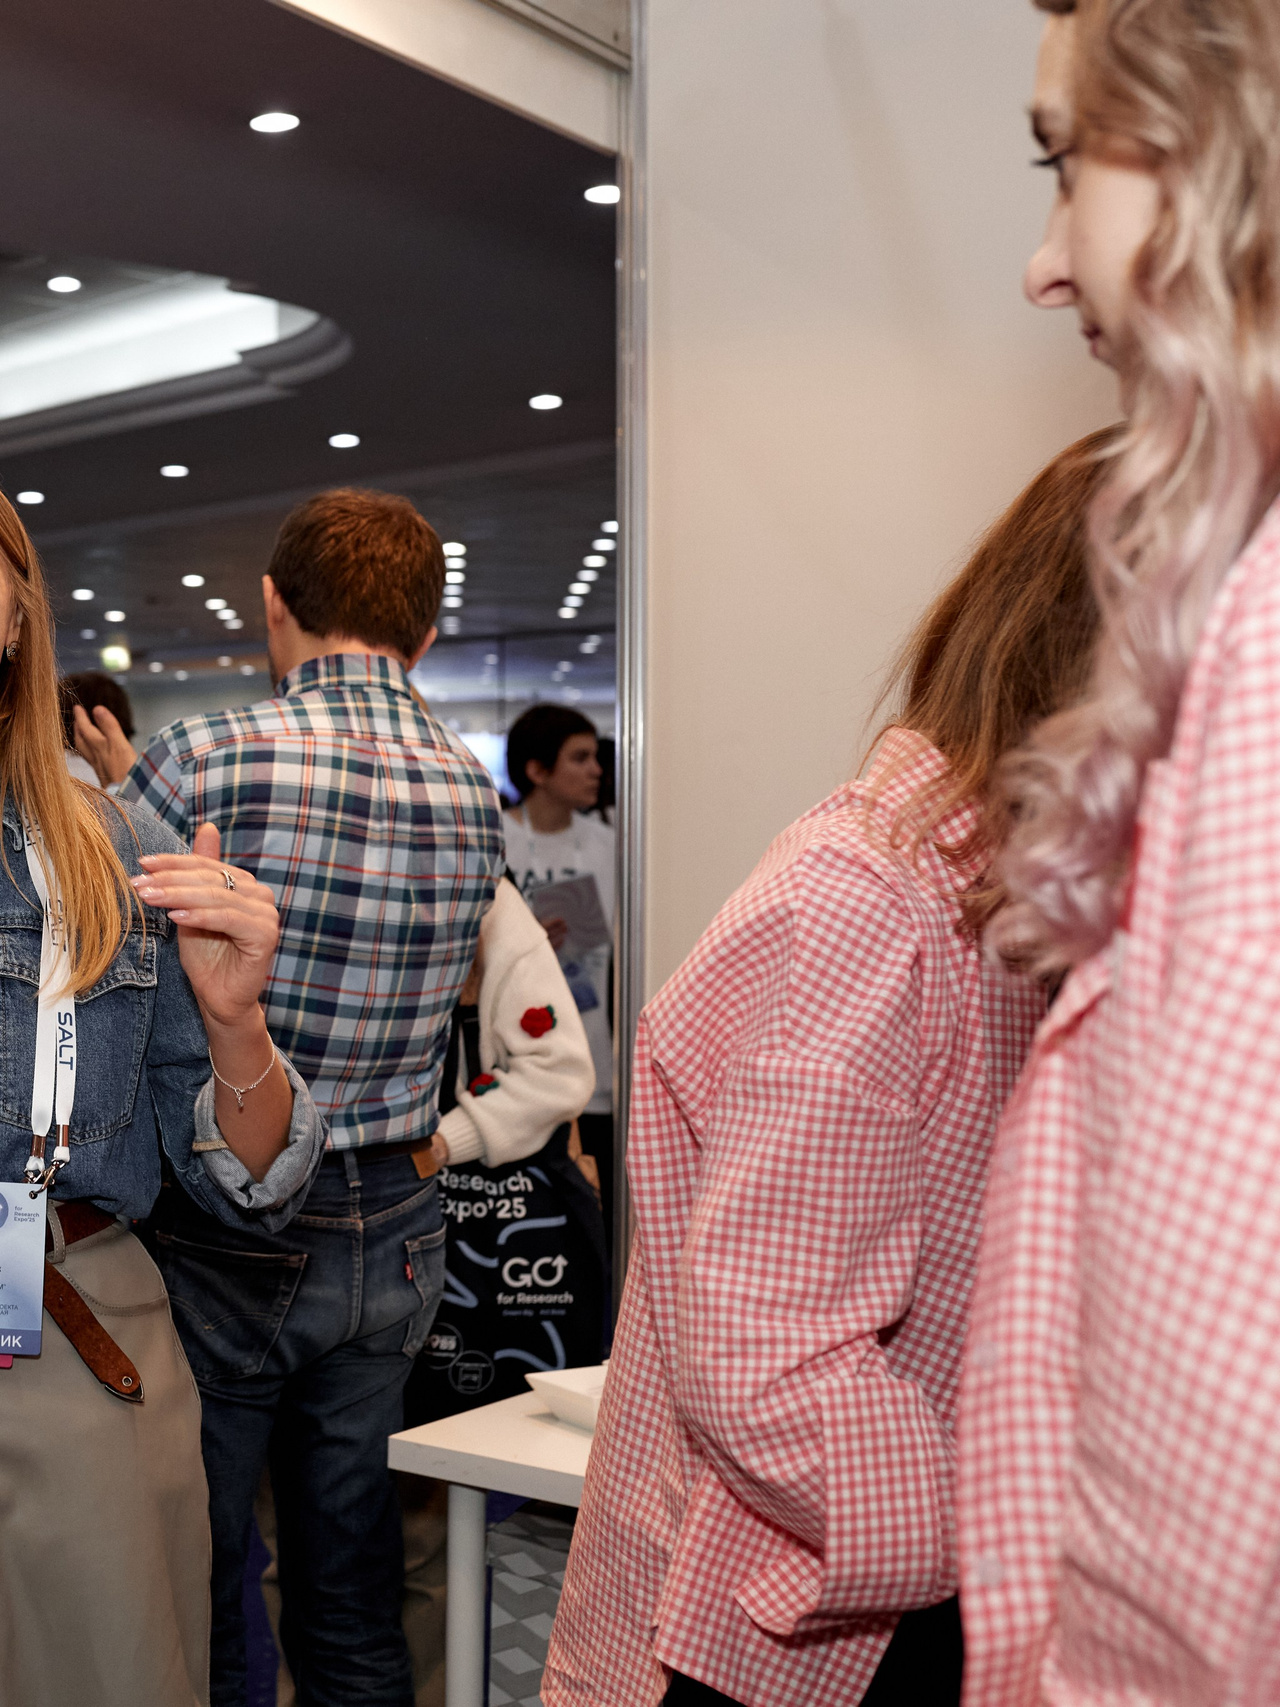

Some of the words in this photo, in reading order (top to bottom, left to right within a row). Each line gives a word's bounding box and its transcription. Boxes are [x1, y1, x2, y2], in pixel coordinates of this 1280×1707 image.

[57, 1011, 74, 1071] SALT
[502, 1255, 568, 1287] GO
[497, 1292, 515, 1305] for
[517, 1291, 574, 1305] Research
